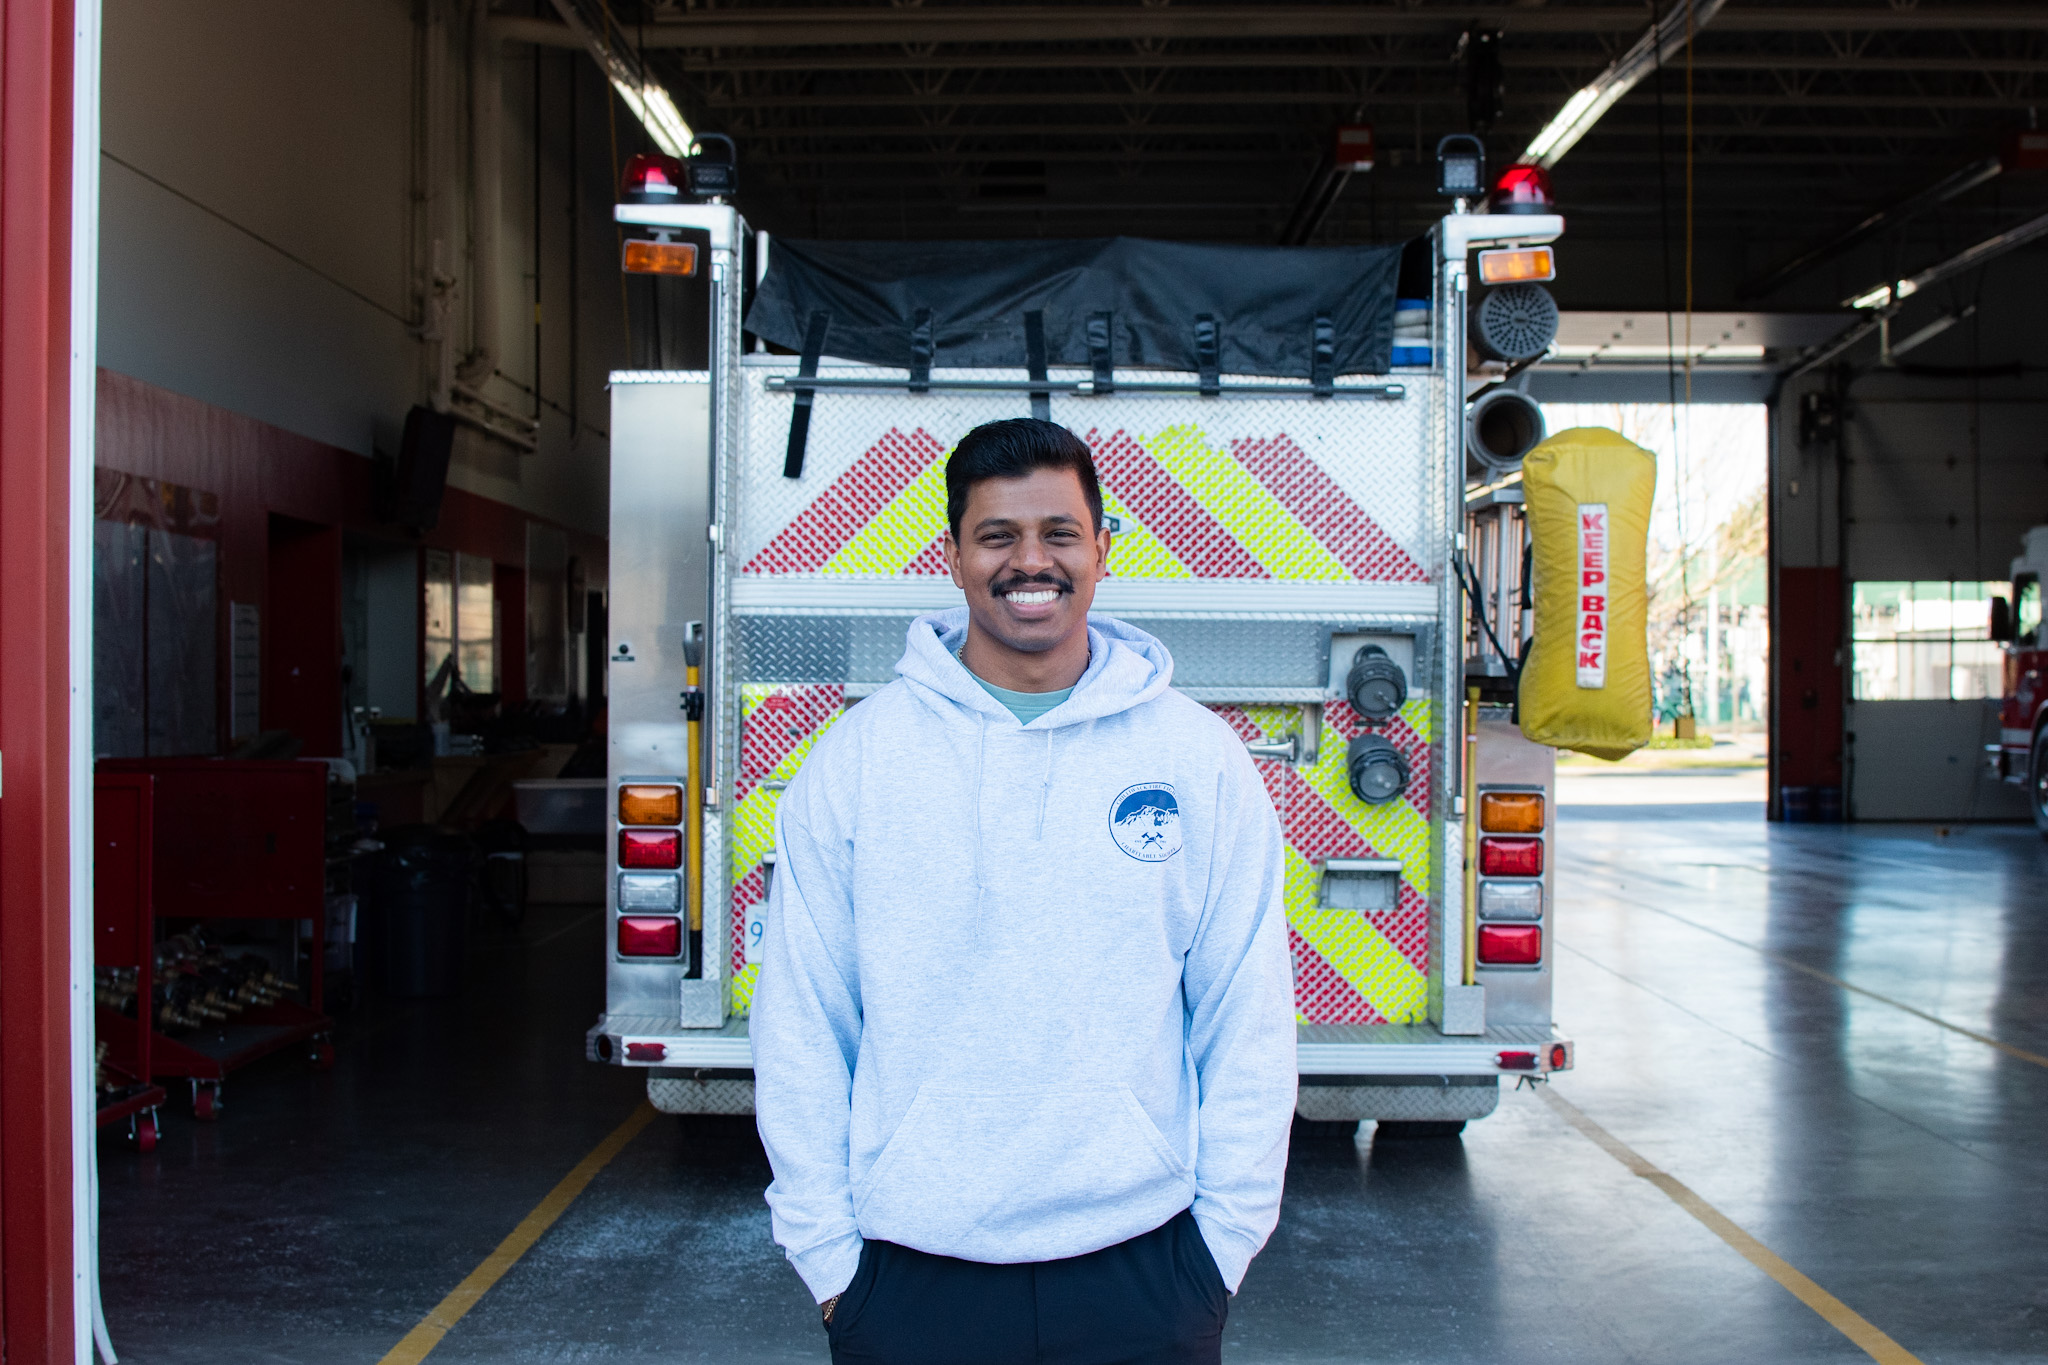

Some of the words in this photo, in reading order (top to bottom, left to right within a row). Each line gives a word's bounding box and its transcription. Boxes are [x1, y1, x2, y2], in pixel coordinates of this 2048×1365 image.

[1581, 513, 1605, 588] KEEP
[1579, 595, 1605, 669] BACK
[1121, 841, 1156, 859] CHARITABLE
